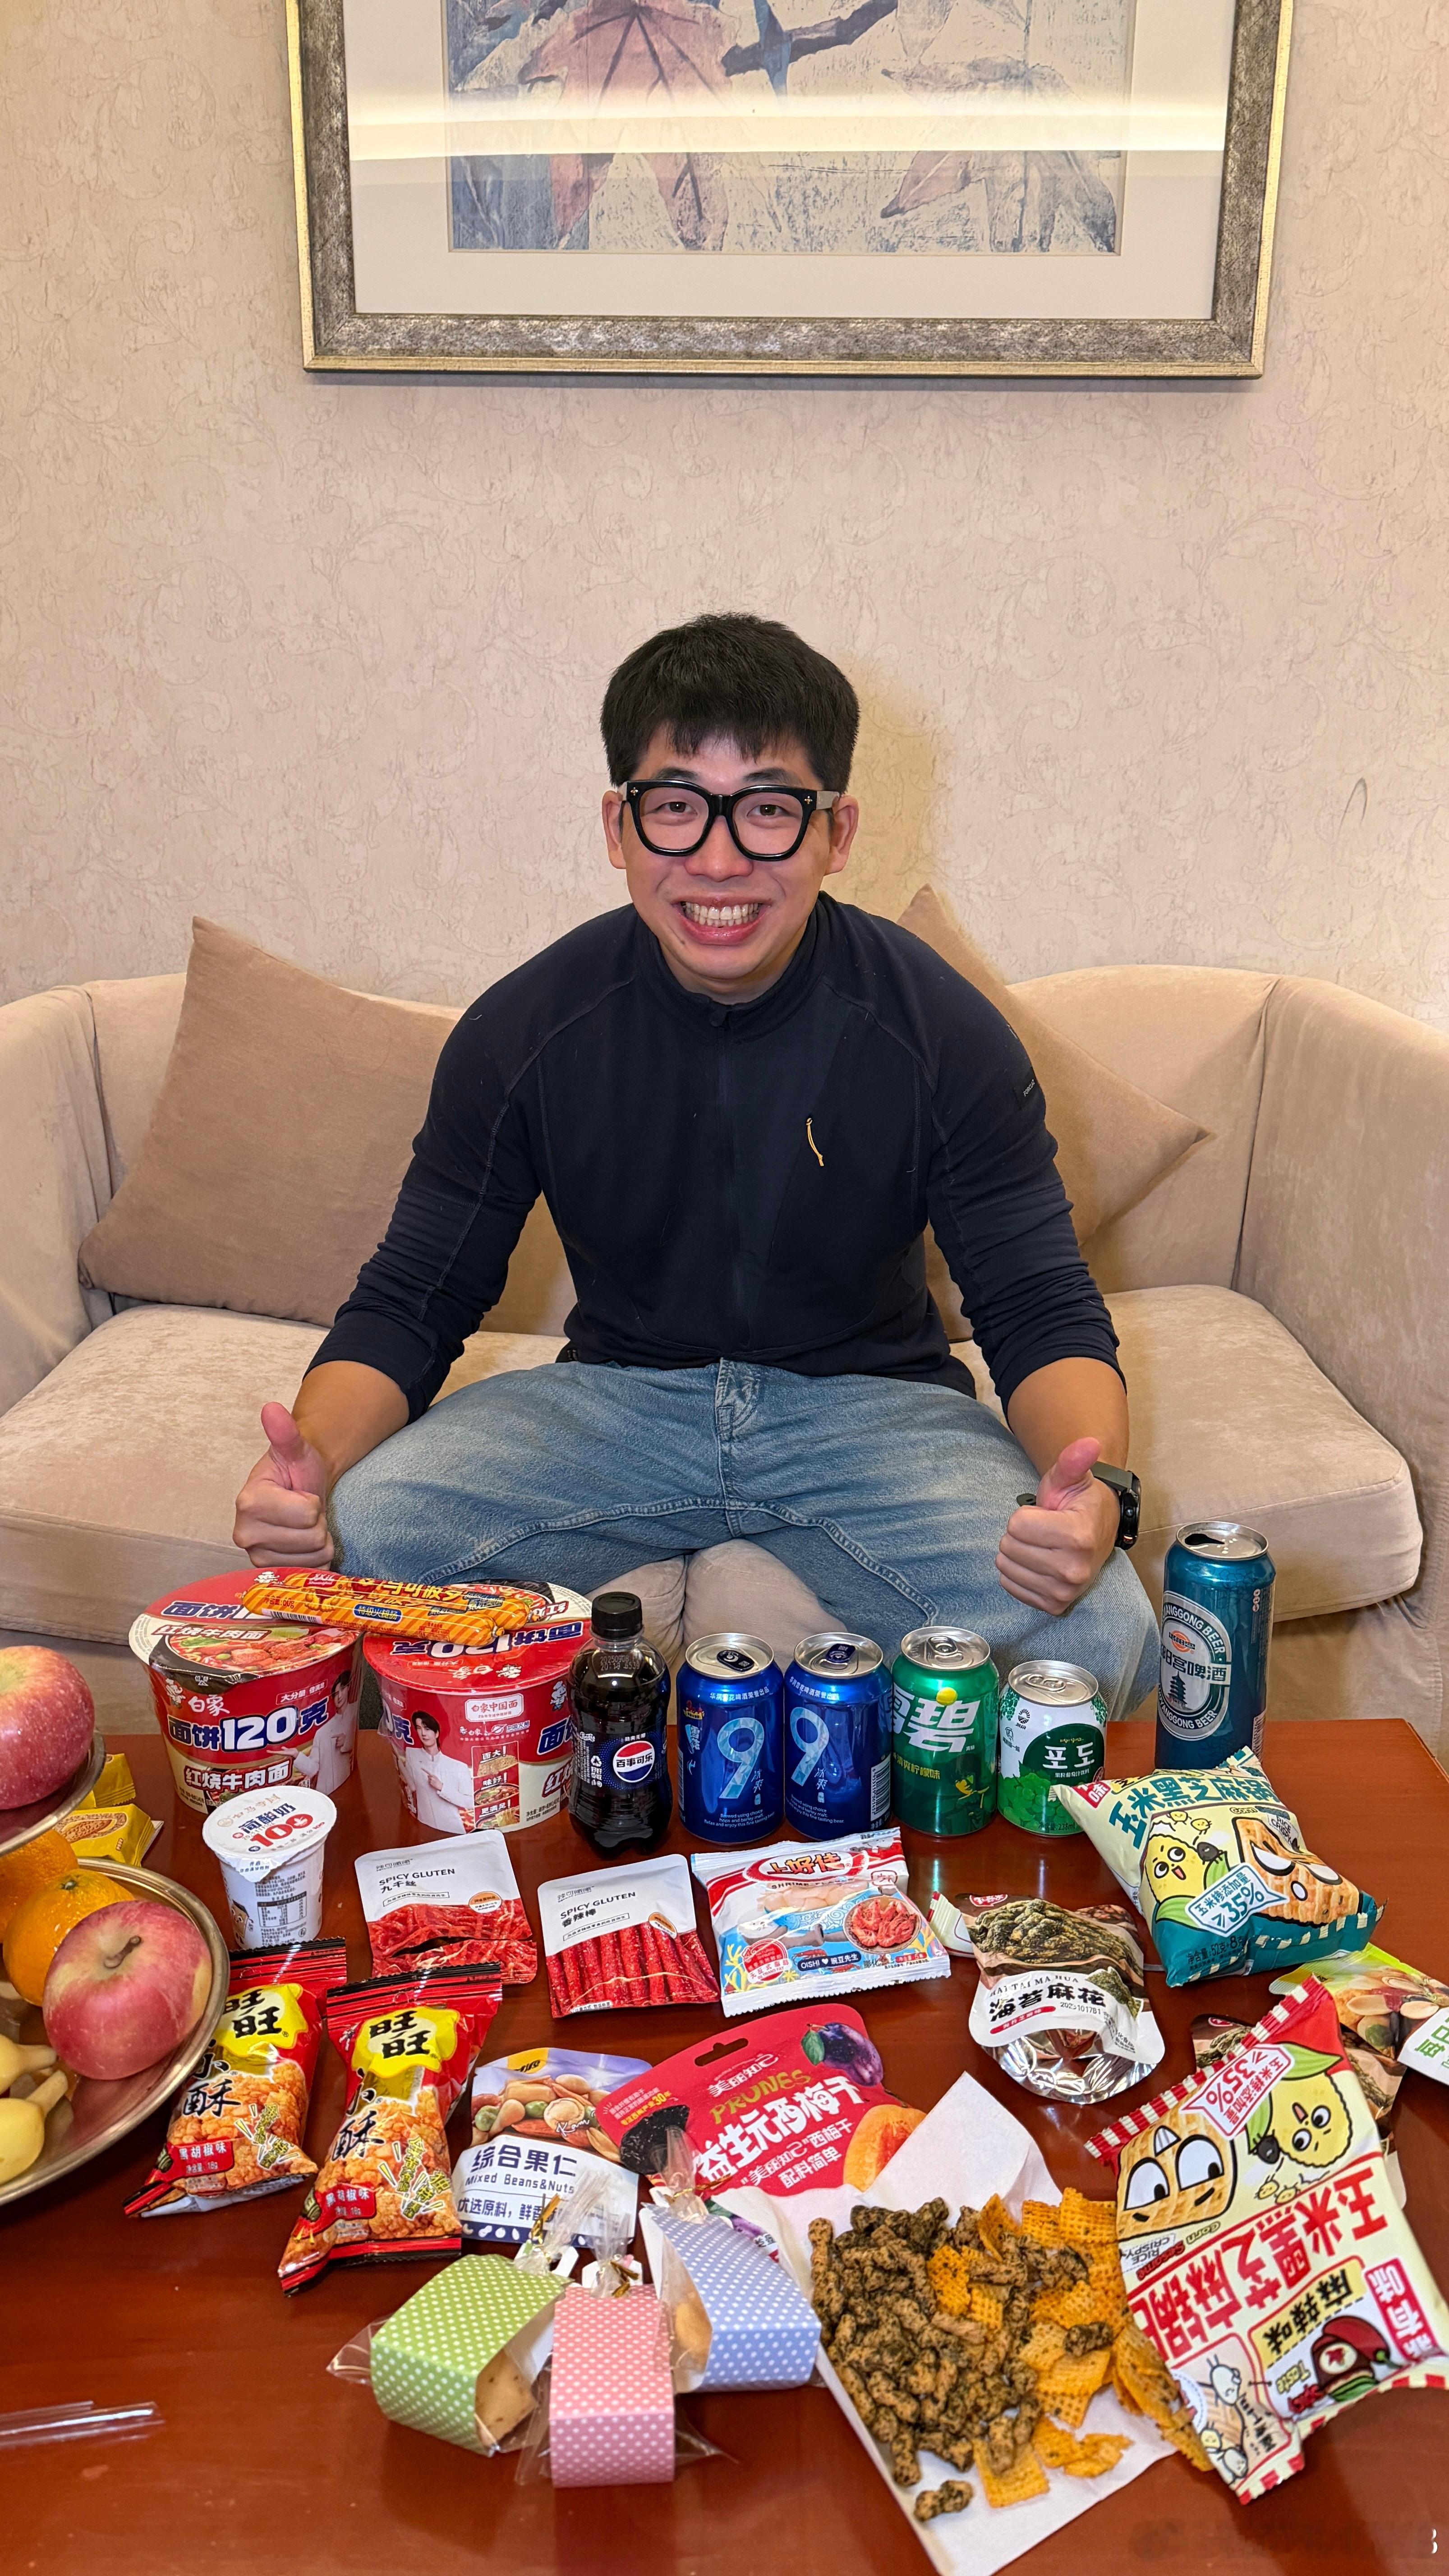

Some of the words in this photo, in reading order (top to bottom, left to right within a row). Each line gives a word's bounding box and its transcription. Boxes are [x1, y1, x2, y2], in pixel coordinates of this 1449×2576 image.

[152, 1624, 271, 1642] 红烧牛肉面
[1201, 1624, 1225, 1654] BEER
[1162, 1644, 1227, 1681] 阳宫啤酒
[167, 1696, 330, 1753] 面饼120克
[1194, 1709, 1218, 1729] BEER
[717, 1717, 764, 1799] 9
[790, 1707, 830, 1787] 9
[1042, 1742, 1095, 1770] 포도
[616, 1753, 653, 1769] 百事可乐
[897, 1757, 941, 1780] 清爽柠檬味
[185, 1760, 291, 1790] 红烧牛肉面
[1230, 1806, 1258, 1814] Corn
[1271, 1819, 1293, 1844] CRISPY
[1276, 1815, 1291, 1832] RICE
[767, 1852, 846, 1875] 上好佳
[378, 1873, 409, 1886] SPICY
[412, 1868, 455, 1880] GLUTEN
[560, 1902, 590, 1920] SPICY
[593, 1891, 636, 1907] GLUTEN
[561, 1908, 597, 1927] 香辣棒
[800, 1959, 821, 1969] OISHI
[830, 1953, 859, 1966] 豌豆先生
[1012, 1980, 1031, 1992] TAI
[1035, 1976, 1051, 1984] MA
[1055, 1974, 1079, 1983] HUA
[224, 1988, 282, 2039] 旺旺
[989, 1983, 1106, 2022] 海苔麻花
[369, 2010, 430, 2058] 旺旺
[707, 2053, 780, 2098] 美丽知己
[709, 2069, 811, 2125] PRUNES
[694, 2075, 865, 2184] 益生元西梅干
[179, 2141, 227, 2160] 黑胡椒味
[471, 2144, 578, 2177] 综合果仁
[778, 2147, 842, 2190] 配料简单
[465, 2173, 498, 2187] Mixed
[504, 2176, 575, 2194] Beans&Nuts
[325, 2189, 370, 2208] 黑胡椒味
[1186, 2221, 1221, 2245] Corn
[1125, 2236, 1171, 2259] CRISPY
[1132, 2247, 1160, 2265] RICE
[1266, 2268, 1353, 2357] 麻辣味
